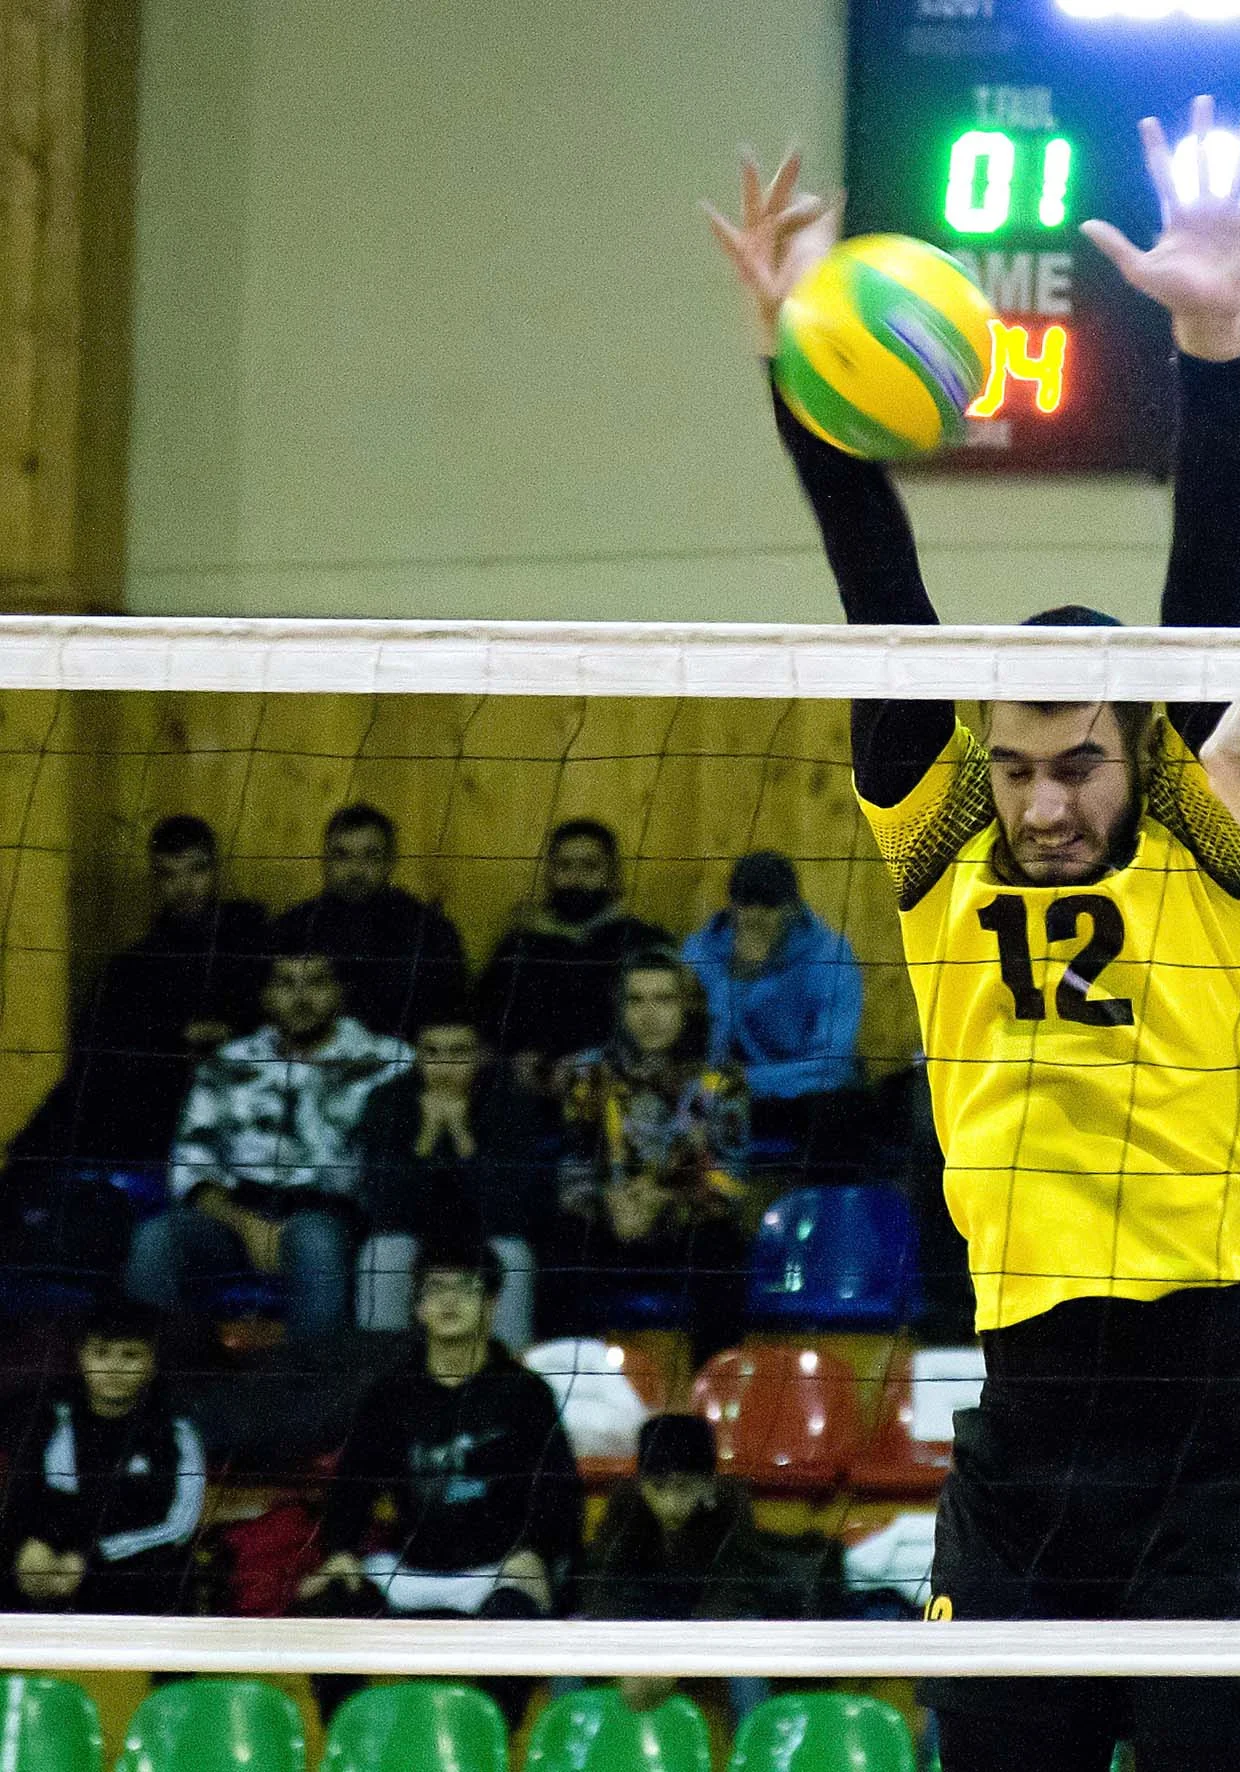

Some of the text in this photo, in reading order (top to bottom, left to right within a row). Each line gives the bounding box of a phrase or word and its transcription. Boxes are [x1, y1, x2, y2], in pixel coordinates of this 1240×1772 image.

[944, 130, 1071, 234] 01
[952, 251, 1073, 314] ME
[976, 893, 1135, 1027] 12
